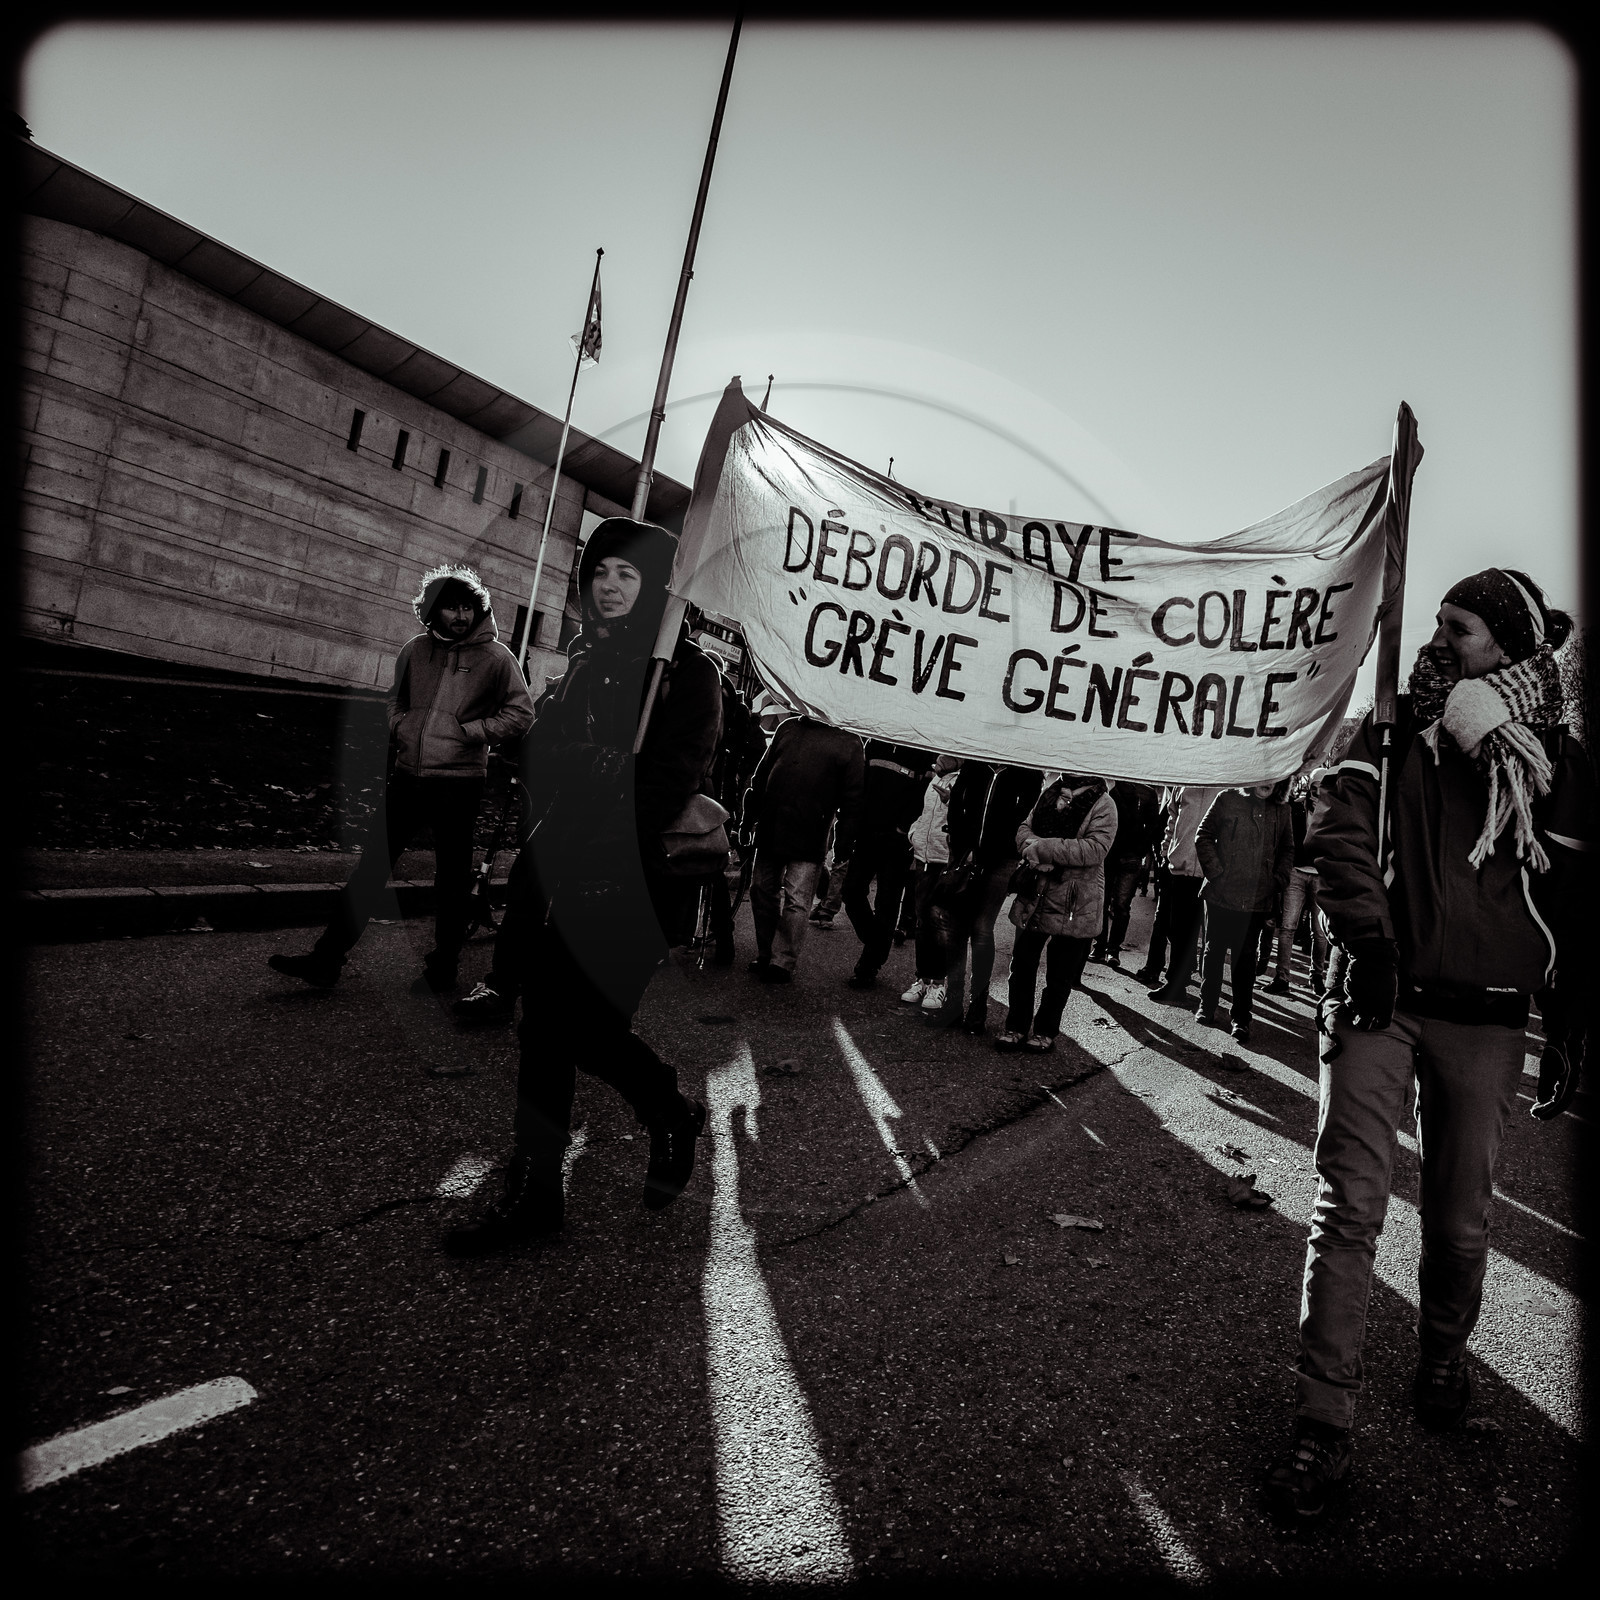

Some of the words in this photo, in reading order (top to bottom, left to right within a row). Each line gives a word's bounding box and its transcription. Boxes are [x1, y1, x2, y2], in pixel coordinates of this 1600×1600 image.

[782, 506, 1014, 623] DÉBORDE
[1050, 579, 1119, 639] DE
[1150, 574, 1354, 652] COLÈRE
